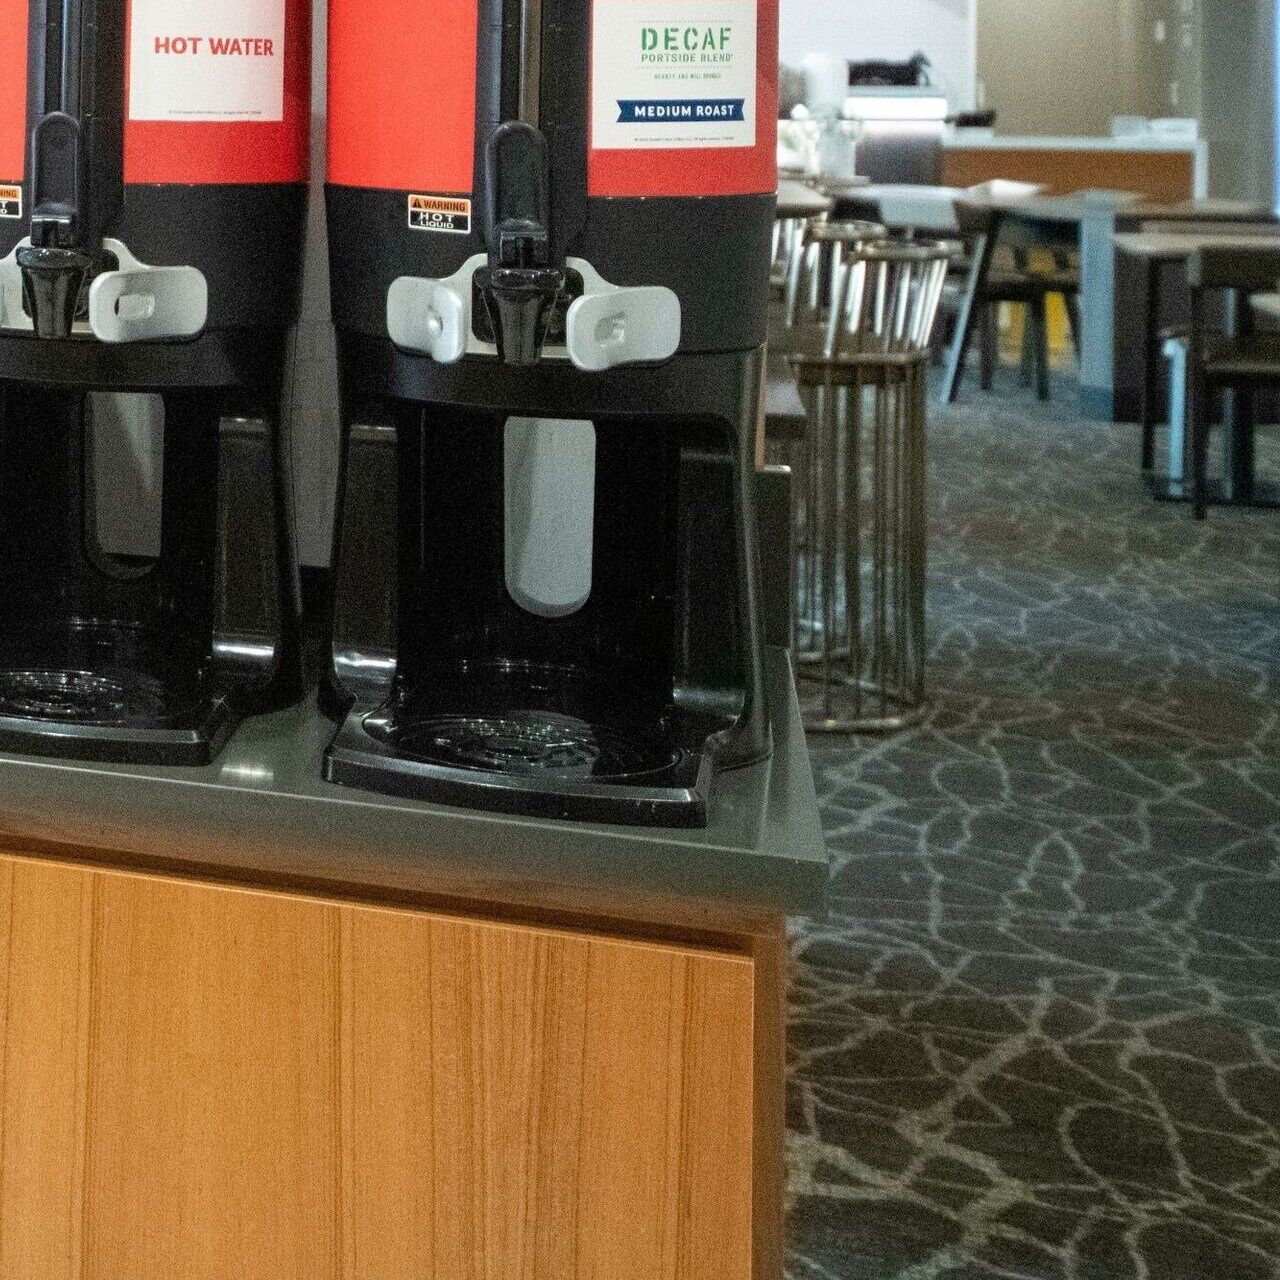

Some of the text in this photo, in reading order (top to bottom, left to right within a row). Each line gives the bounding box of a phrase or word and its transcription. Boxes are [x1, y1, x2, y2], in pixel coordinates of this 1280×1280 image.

[640, 26, 732, 51] DECAF
[154, 36, 274, 57] HOT WATER
[640, 53, 732, 63] PORTSIDE BLEND
[633, 103, 735, 117] MEDIUM ROAST
[423, 199, 466, 212] WARNING
[419, 211, 455, 223] HOT
[420, 219, 454, 229] LIQUID
